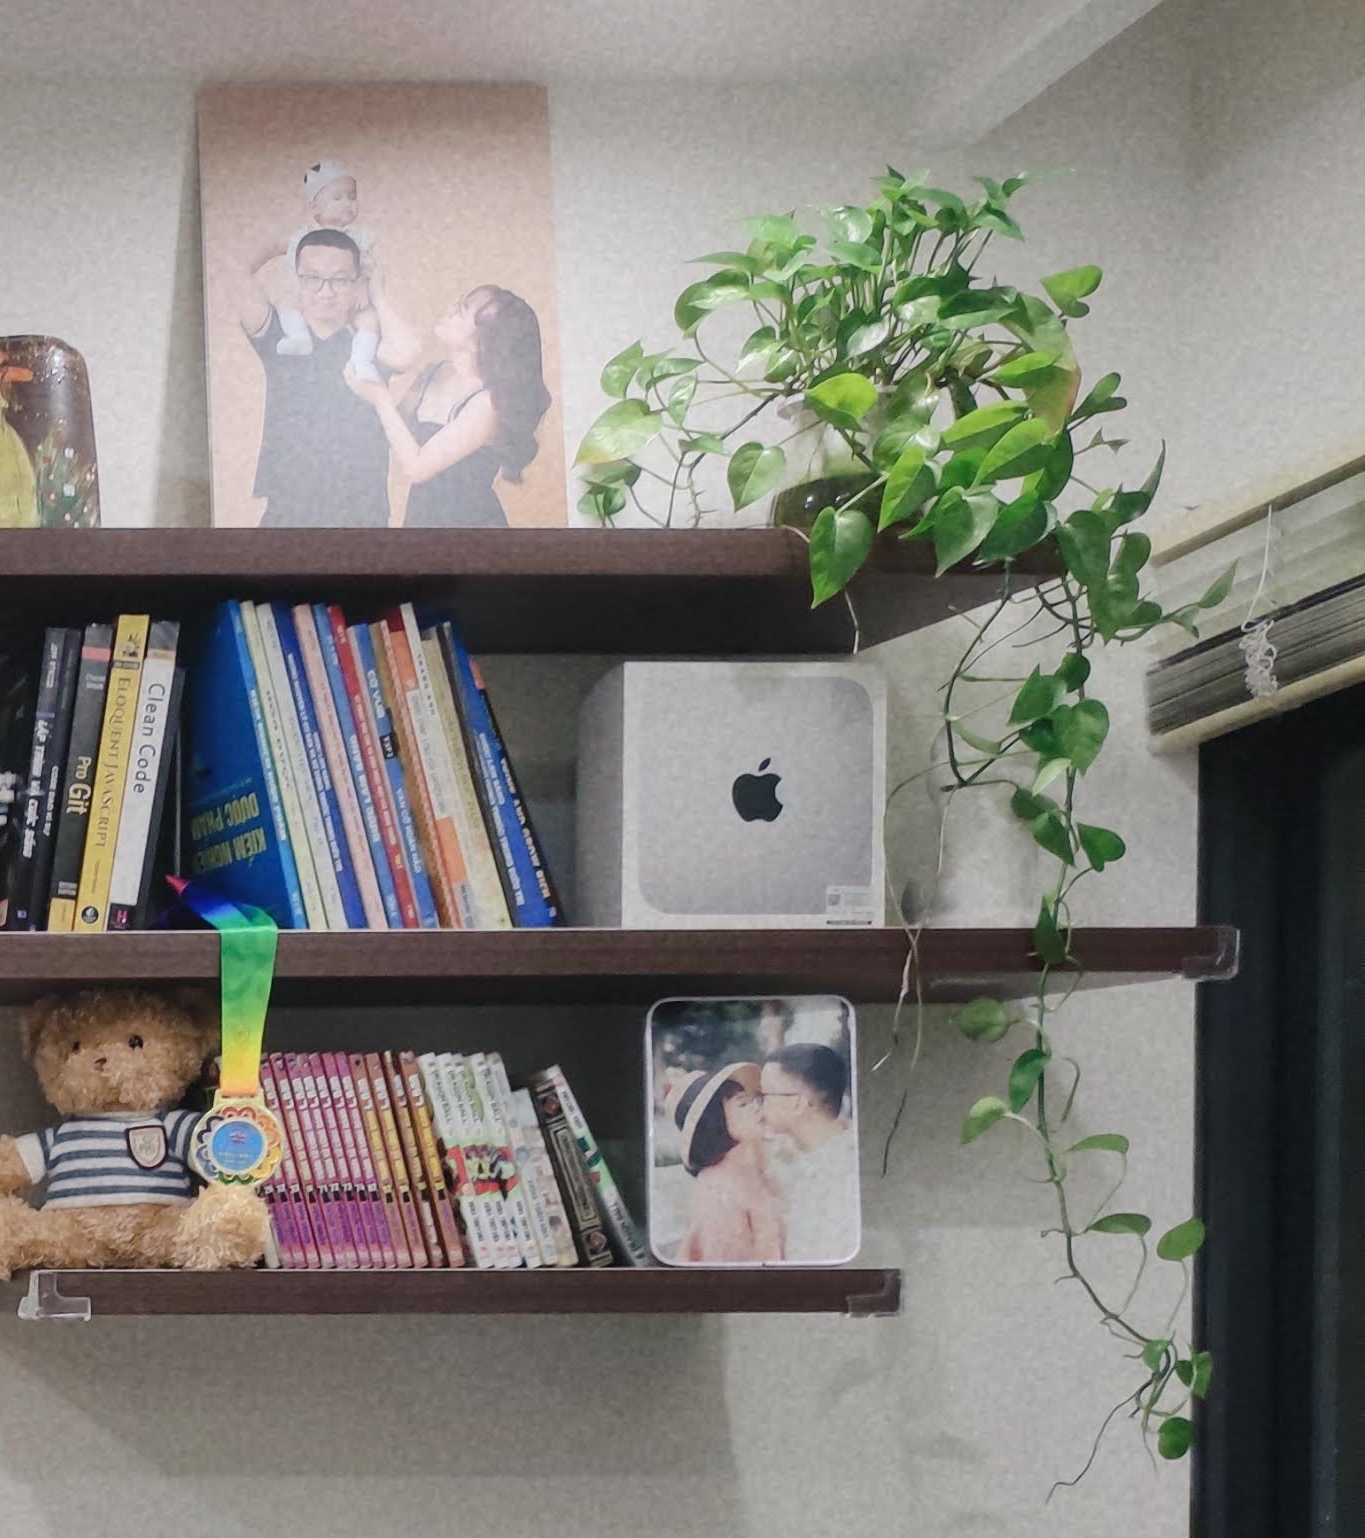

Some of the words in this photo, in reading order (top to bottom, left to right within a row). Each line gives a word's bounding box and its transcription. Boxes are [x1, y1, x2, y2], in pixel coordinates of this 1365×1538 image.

[140, 680, 167, 739] Clean
[74, 754, 92, 781] Pro
[132, 742, 157, 796] Code
[64, 780, 92, 817] Git
